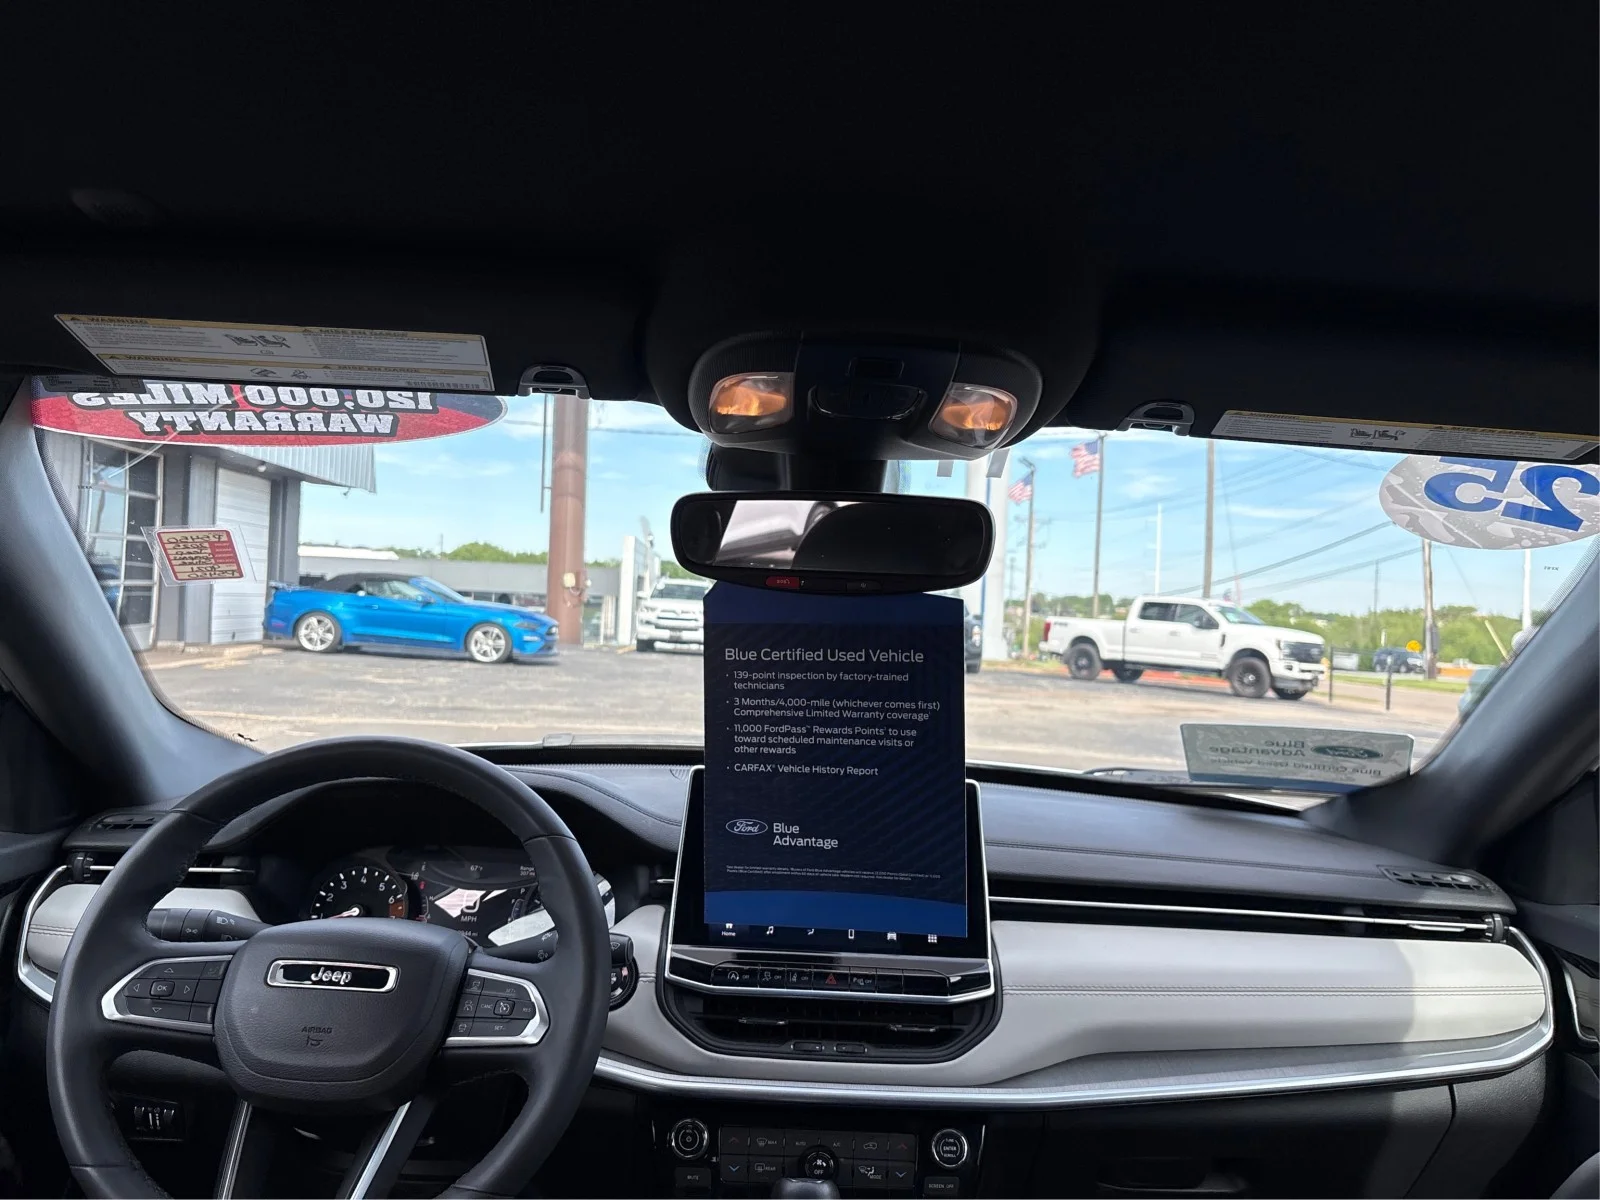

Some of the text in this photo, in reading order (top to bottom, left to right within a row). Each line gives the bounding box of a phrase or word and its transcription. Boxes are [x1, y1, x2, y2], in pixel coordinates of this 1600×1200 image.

[725, 648, 924, 663] Blue Certified Used Vehicle
[733, 671, 909, 682] 139-point inspection by factory-trained
[734, 682, 784, 690] technicians
[734, 698, 940, 711] 3 Months/4,000-mile (whichever comes first)
[734, 708, 804, 718] Comprehensive
[806, 709, 840, 718] Limited
[842, 710, 884, 720] Warranty
[734, 725, 762, 734] 11,000
[813, 726, 852, 735] Rewards
[889, 727, 898, 736] to
[901, 728, 917, 737] use
[734, 735, 914, 747] toward scheduled maintenance visits or
[778, 765, 810, 774] Vehicle
[812, 765, 845, 776] History
[847, 766, 878, 776] Report
[773, 823, 800, 834] Blue
[773, 836, 839, 849] Advantage
[360, 875, 367, 884] 4
[340, 881, 348, 890] 3
[378, 882, 386, 891] 5
[326, 893, 334, 902] 2
[388, 895, 395, 904] 6
[310, 966, 353, 985] Jeep
[301, 1026, 333, 1034] AIRBAG
